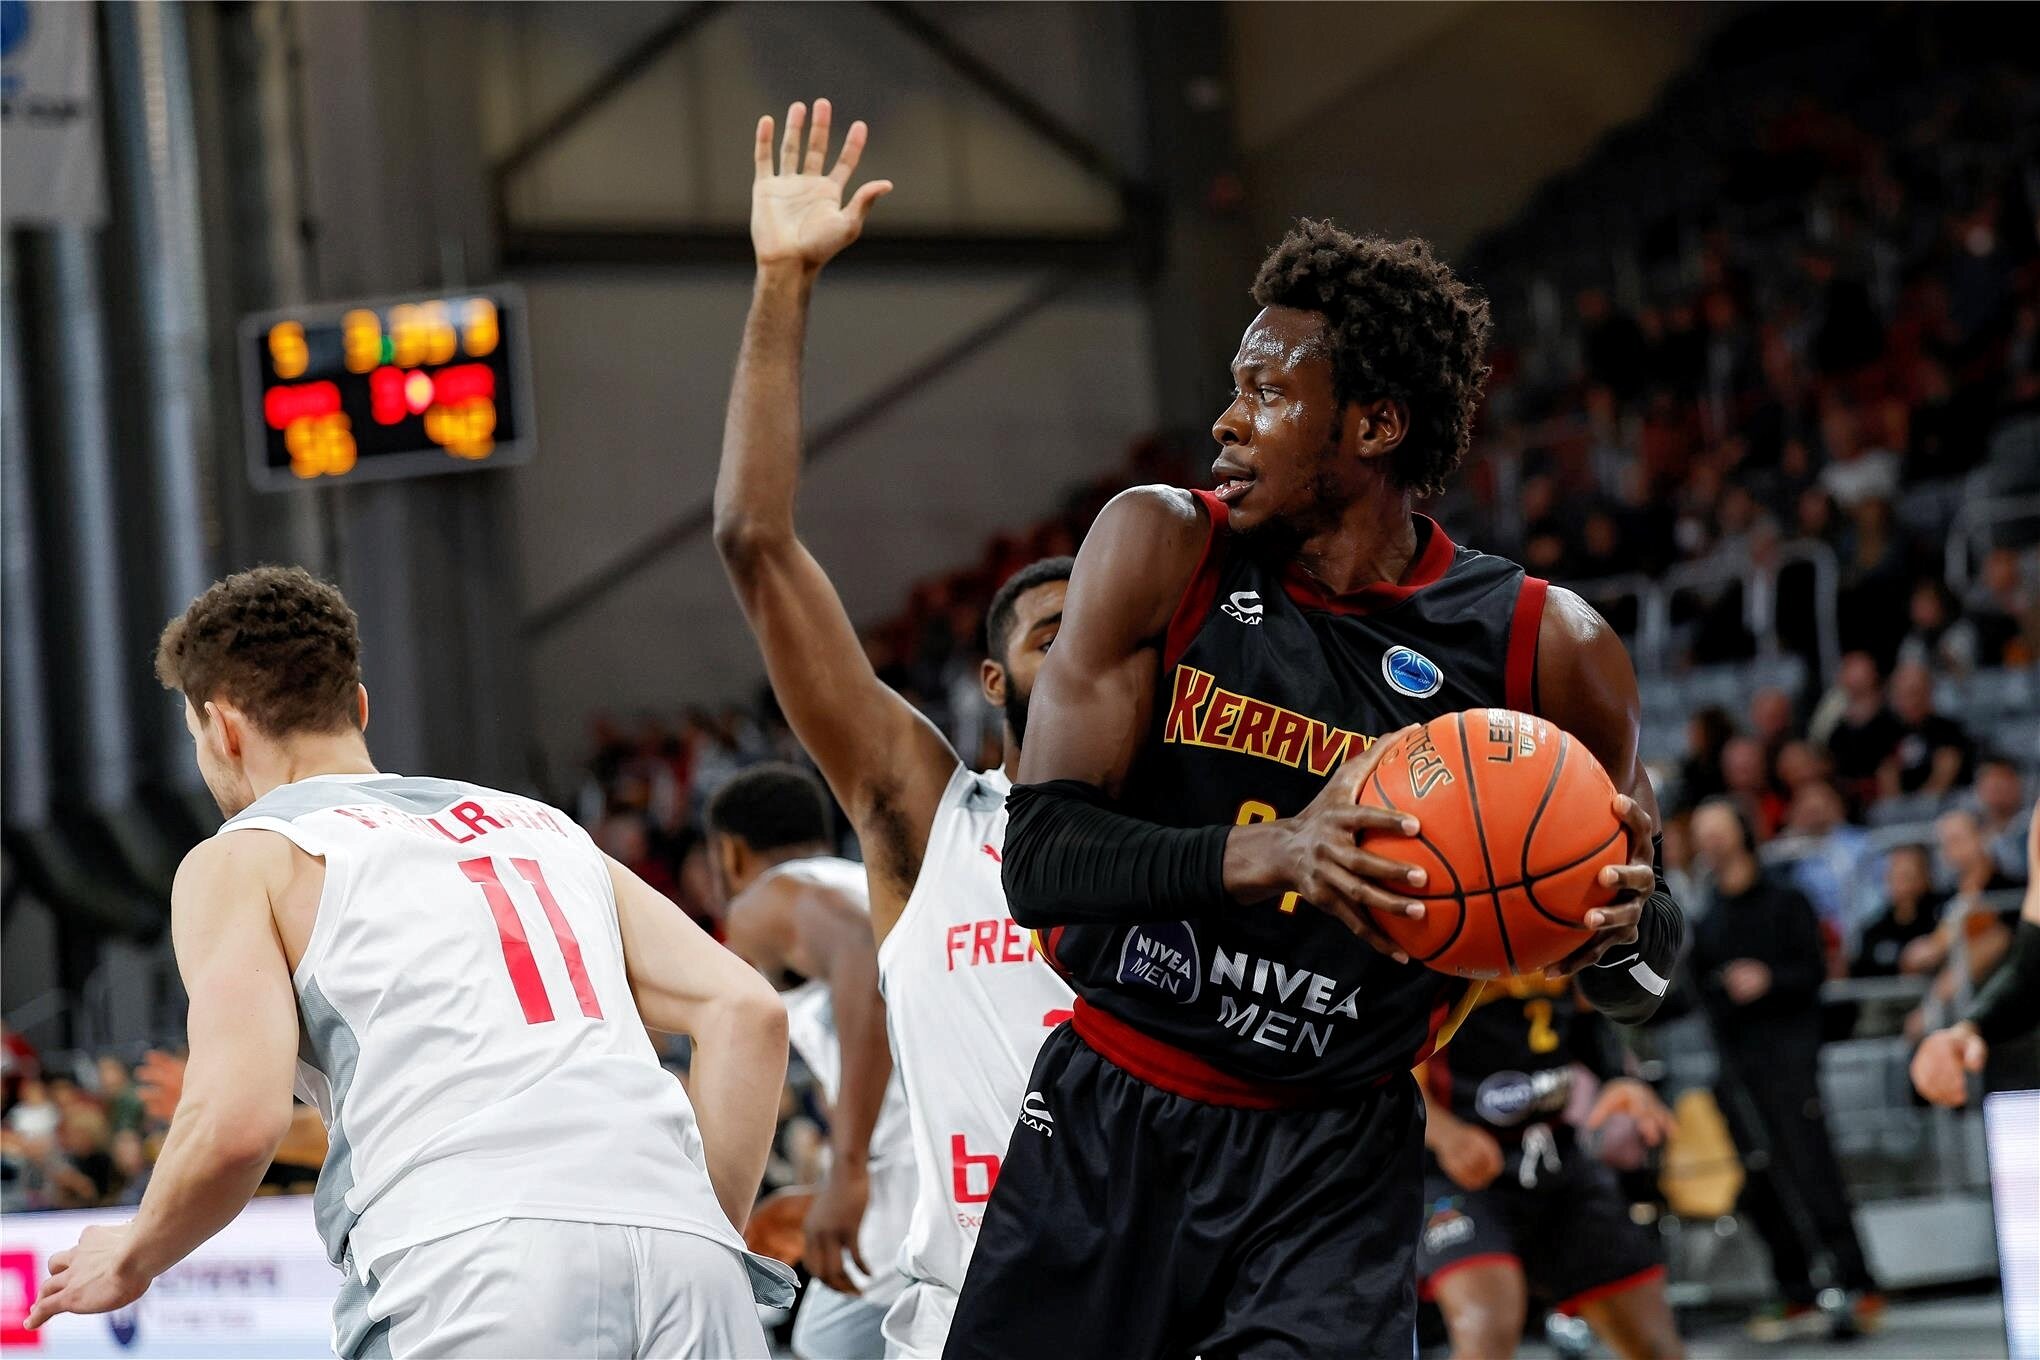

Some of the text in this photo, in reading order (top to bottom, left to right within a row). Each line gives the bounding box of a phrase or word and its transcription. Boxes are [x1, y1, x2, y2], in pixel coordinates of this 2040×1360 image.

[457, 855, 604, 1026] 11
[1136, 933, 1191, 980] NIVEA
[1129, 956, 1181, 994] MEN
[1209, 944, 1362, 1020] NIVEA
[1216, 995, 1335, 1058] MEN
